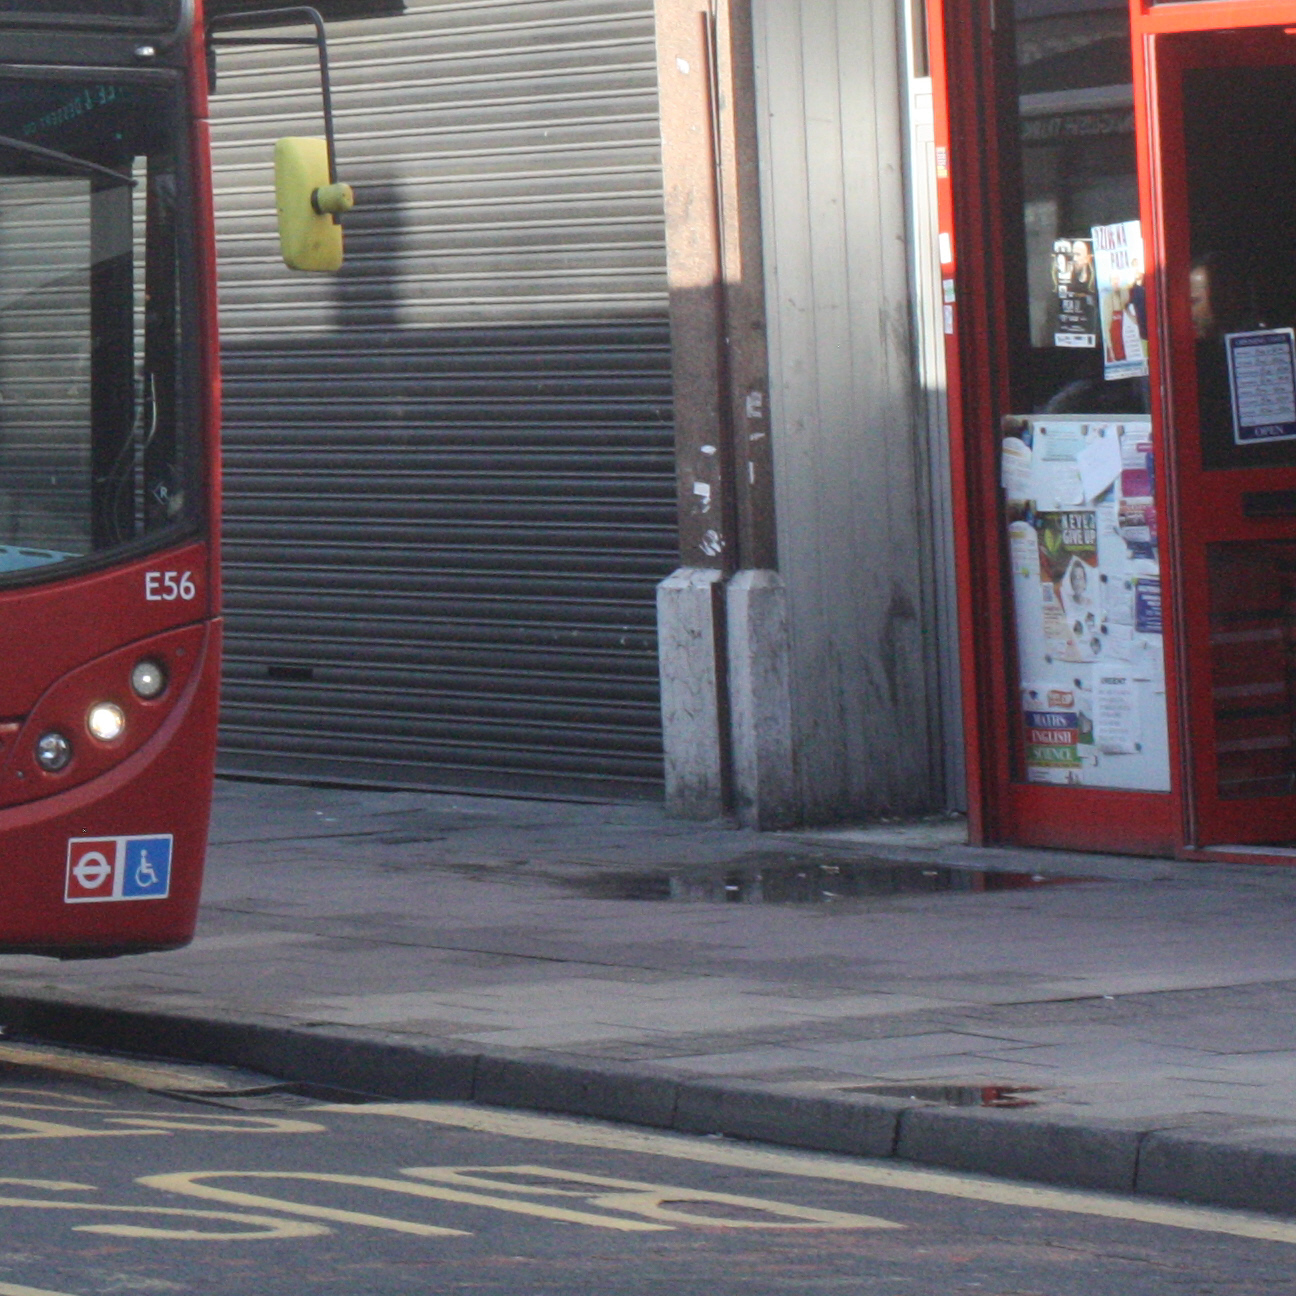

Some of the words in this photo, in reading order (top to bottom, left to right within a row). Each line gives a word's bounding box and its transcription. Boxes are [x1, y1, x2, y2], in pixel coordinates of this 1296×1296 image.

[1062, 512, 1097, 530] NEVER
[1062, 529, 1084, 545] GIVE
[1084, 528, 1097, 545] UP
[144, 570, 196, 602] E56
[1032, 730, 1072, 744] ENGLISH
